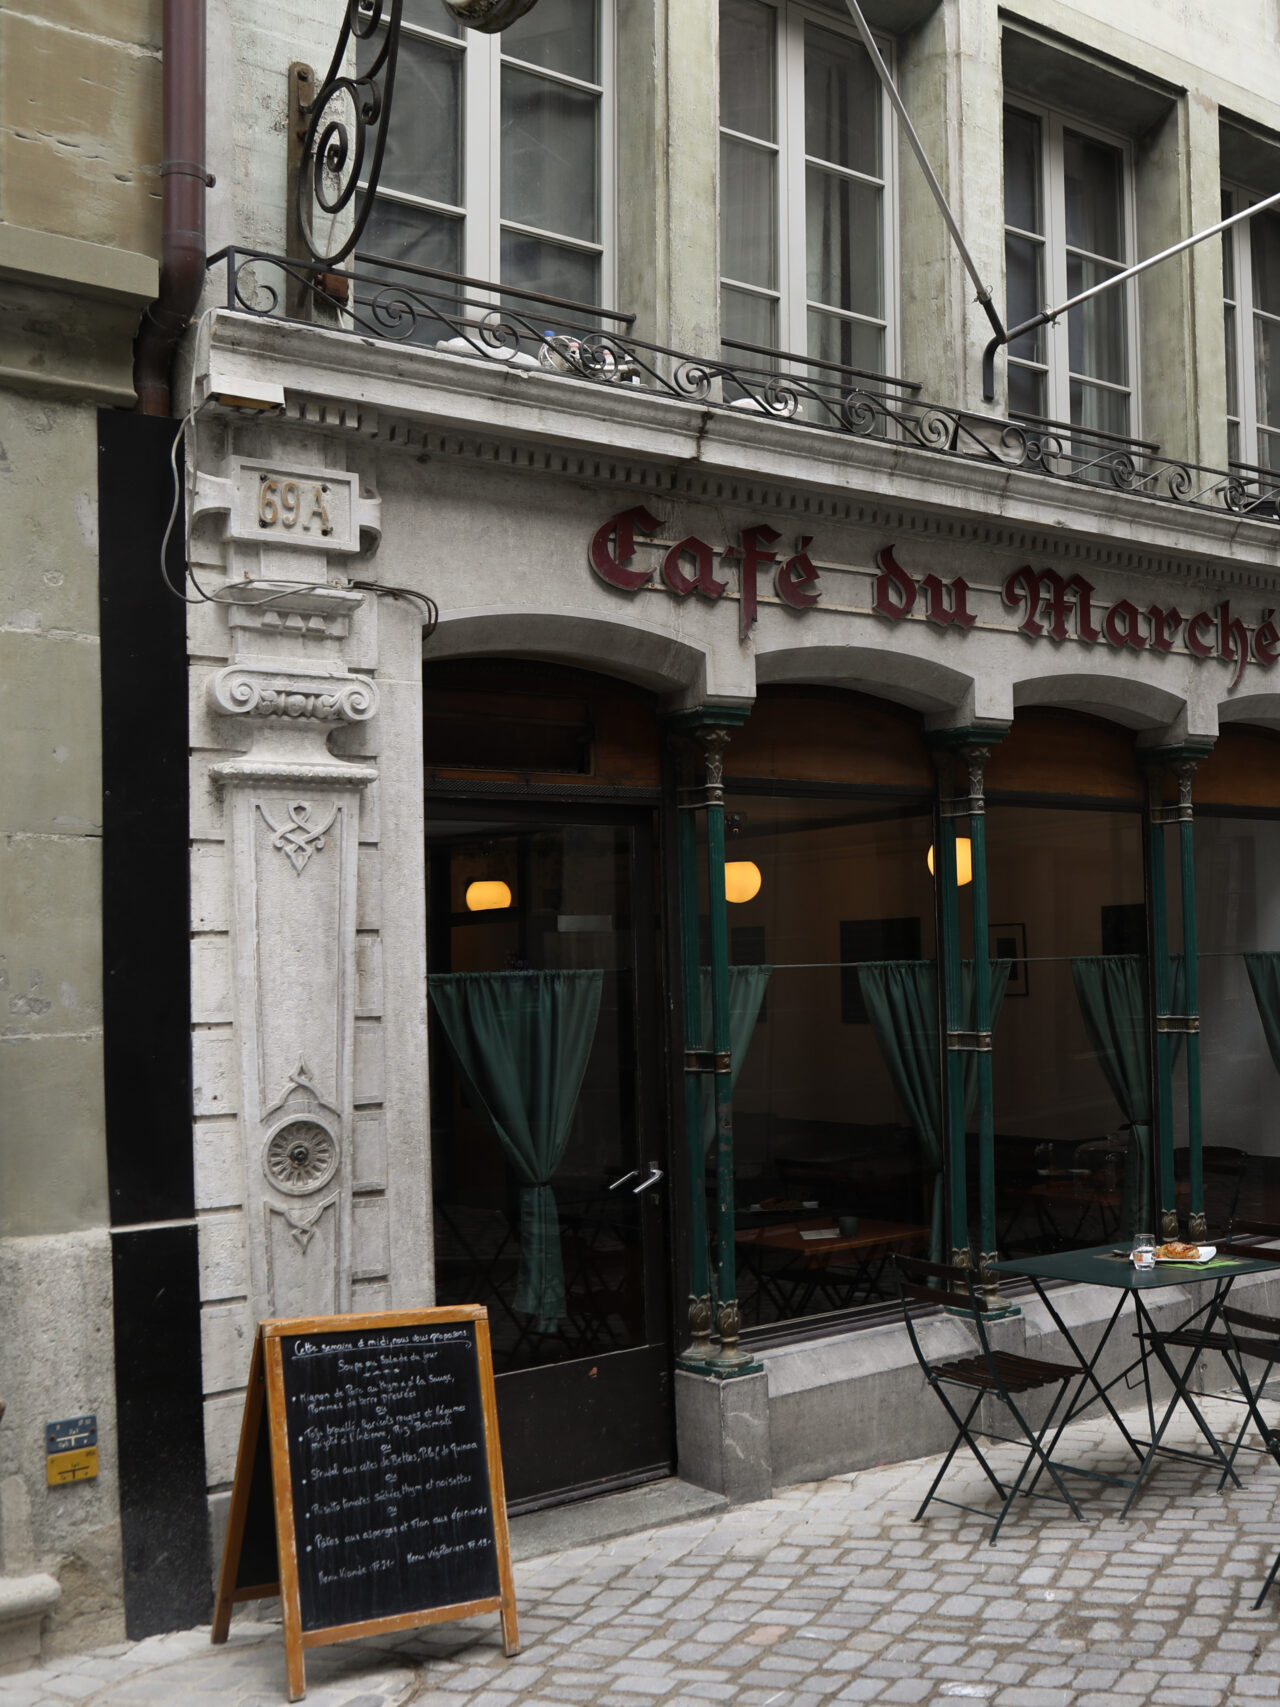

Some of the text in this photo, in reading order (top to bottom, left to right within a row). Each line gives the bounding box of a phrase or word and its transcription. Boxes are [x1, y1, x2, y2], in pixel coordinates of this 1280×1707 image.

[589, 504, 823, 640] Café
[872, 543, 979, 629] du
[295, 1340, 319, 1356] Cette
[322, 1342, 353, 1351] semaine
[338, 1359, 363, 1373] Soupe
[380, 1354, 408, 1365] Salade
[410, 1352, 420, 1361] du
[422, 1351, 439, 1363] jour
[334, 1388, 344, 1398] de
[415, 1375, 427, 1386] la
[347, 1398, 357, 1407] de
[425, 1479, 434, 1490] et
[399, 1522, 408, 1532] et
